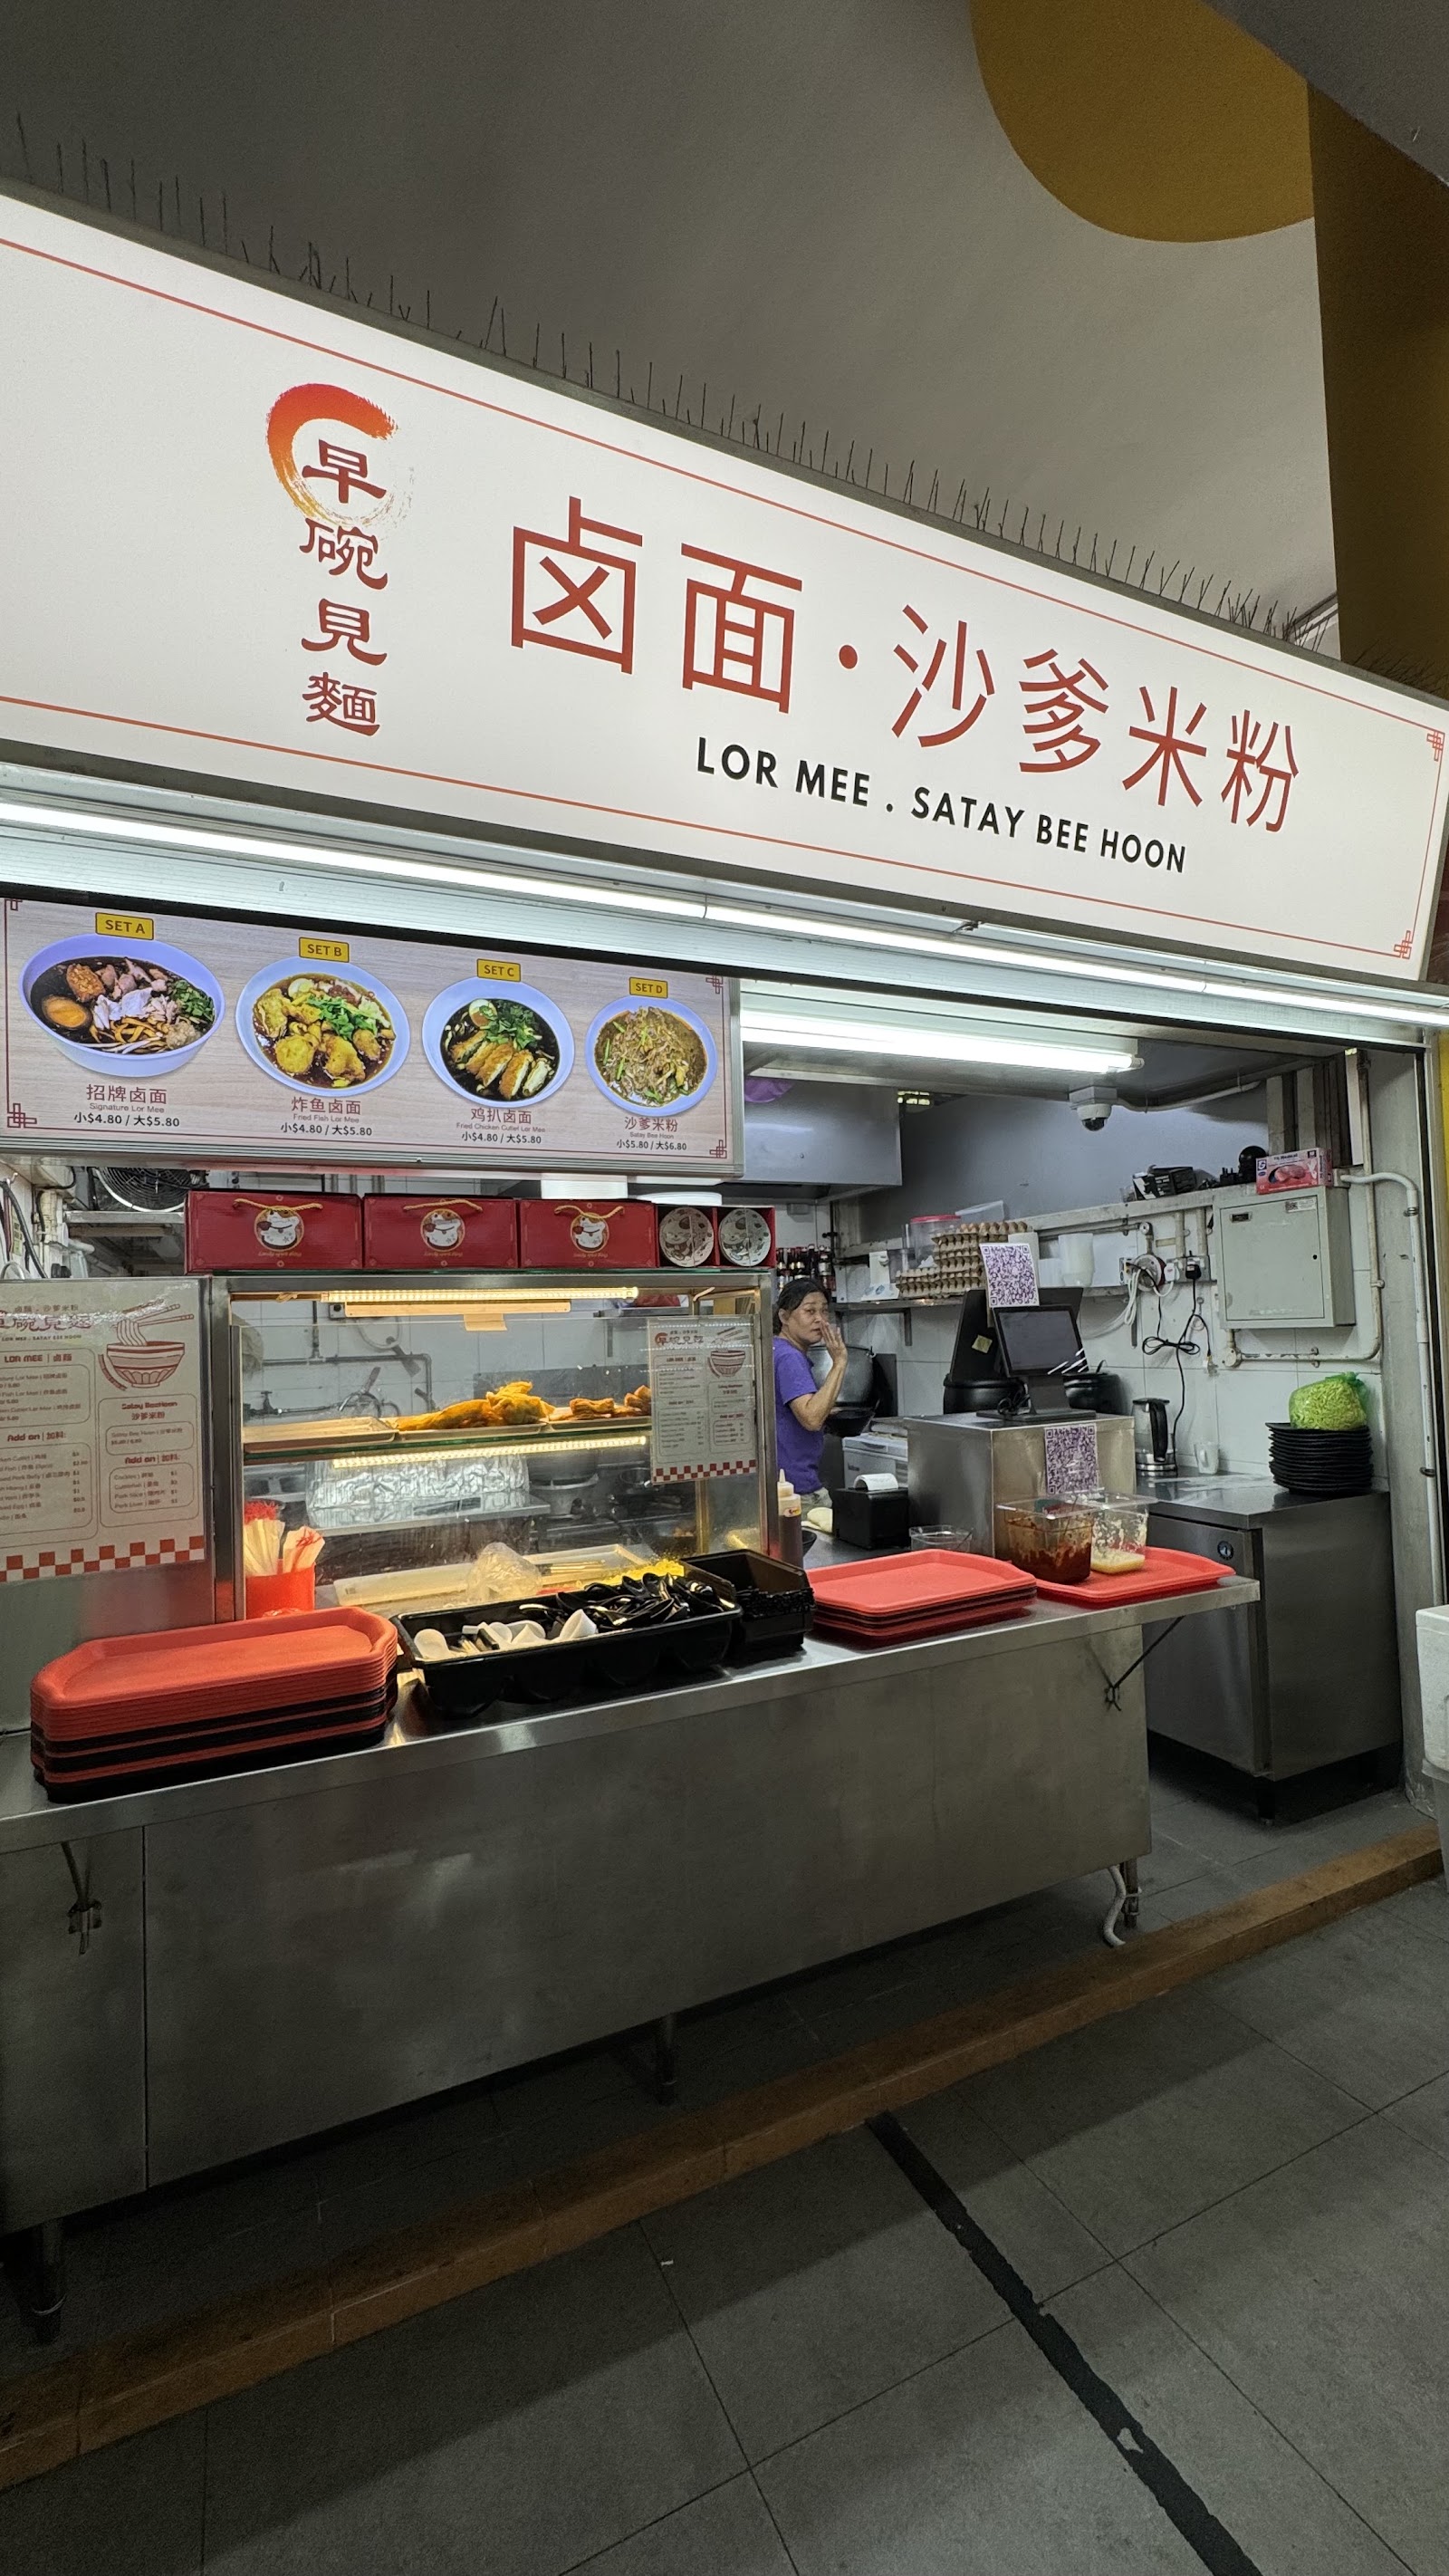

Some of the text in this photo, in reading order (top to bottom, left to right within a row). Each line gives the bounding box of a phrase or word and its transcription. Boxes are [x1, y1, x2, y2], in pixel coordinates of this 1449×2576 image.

[300, 439, 388, 735] 早碗見麵
[697, 736, 778, 788] LOR
[795, 760, 870, 807] MEE
[911, 786, 1025, 838] SATAY
[1036, 814, 1089, 853] BEE
[1099, 828, 1186, 873] HOON
[105, 919, 145, 934] SET A
[307, 944, 342, 956] SET B
[484, 965, 514, 977] SET C
[635, 982, 663, 994] SET D
[86, 1083, 168, 1105] 招牌卤面
[89, 1102, 130, 1112] Signature
[291, 1096, 361, 1116] 炸鱼卤面
[73, 1111, 122, 1124] 小$4.80
[133, 1115, 180, 1127] 大$5.80
[293, 1113, 312, 1121] Fried
[313, 1114, 329, 1122] Fish
[470, 1107, 533, 1125] 鸡扒卤面
[280, 1122, 322, 1134] 小$4.80
[331, 1125, 372, 1136] 大$5.80
[624, 1116, 678, 1133] 沙爹米粉
[461, 1130, 498, 1142] 小$4.80
[506, 1133, 542, 1144] 大$5.80
[617, 1139, 649, 1149] 小$5.80
[656, 1140, 687, 1150] 大$6.80
[24, 1354, 43, 1362] MEE
